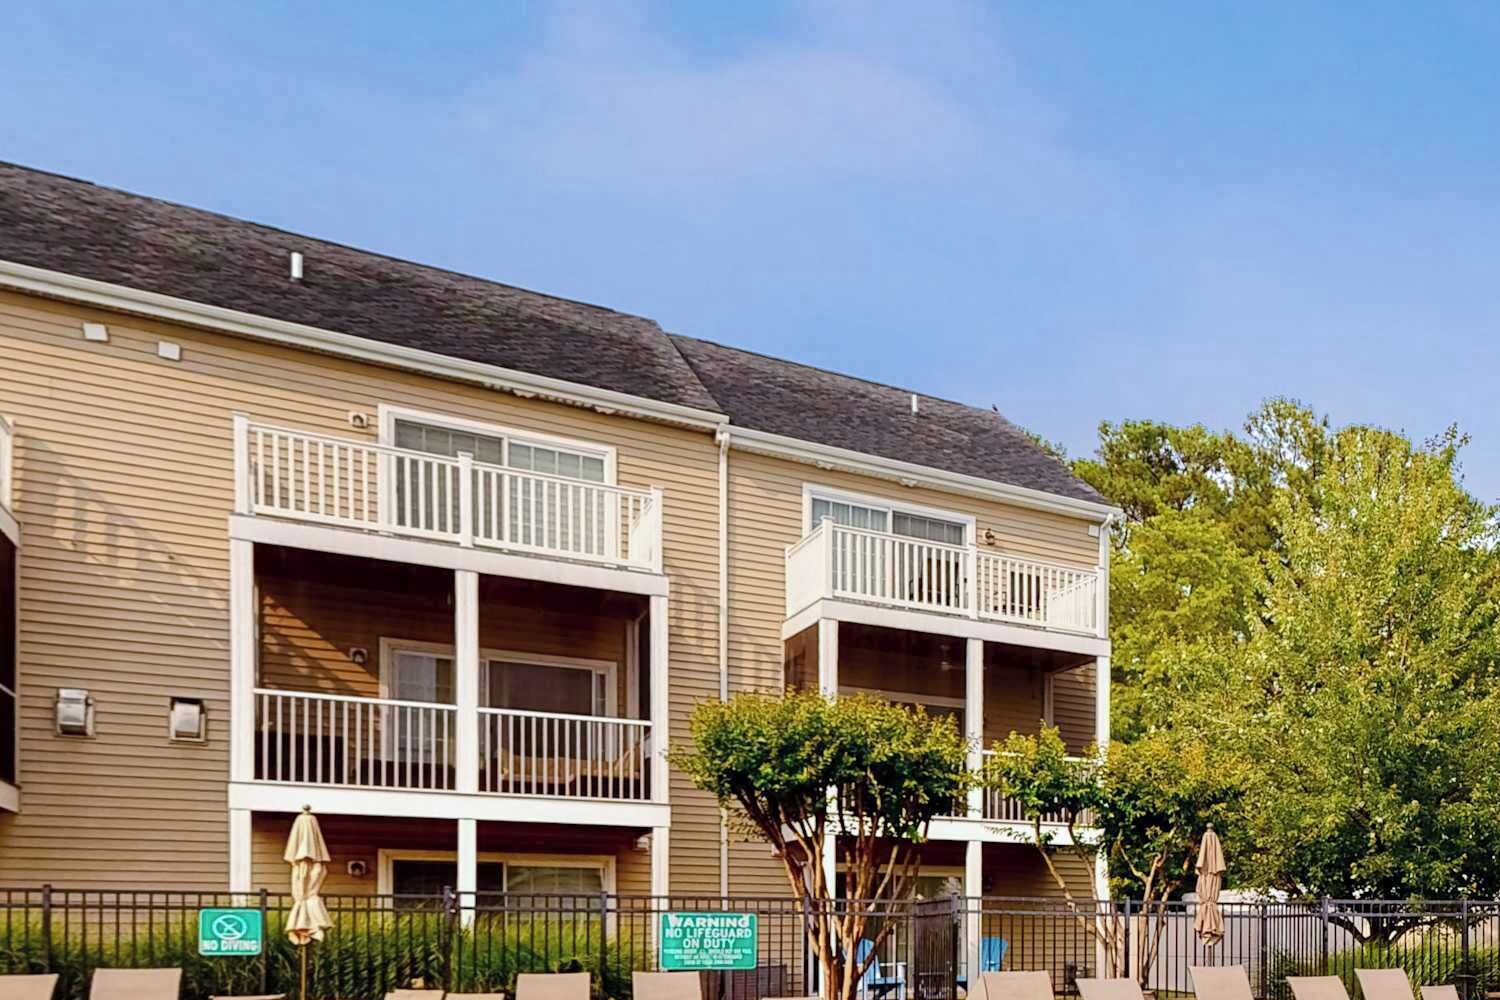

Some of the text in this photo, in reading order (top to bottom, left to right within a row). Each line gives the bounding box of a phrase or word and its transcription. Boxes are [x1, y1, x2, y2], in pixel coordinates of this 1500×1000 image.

[668, 915, 750, 927] WARNING
[665, 928, 752, 938] NO LIFEGUARD
[201, 940, 258, 951] NO DIVING
[683, 939, 735, 949] ON DUTY
